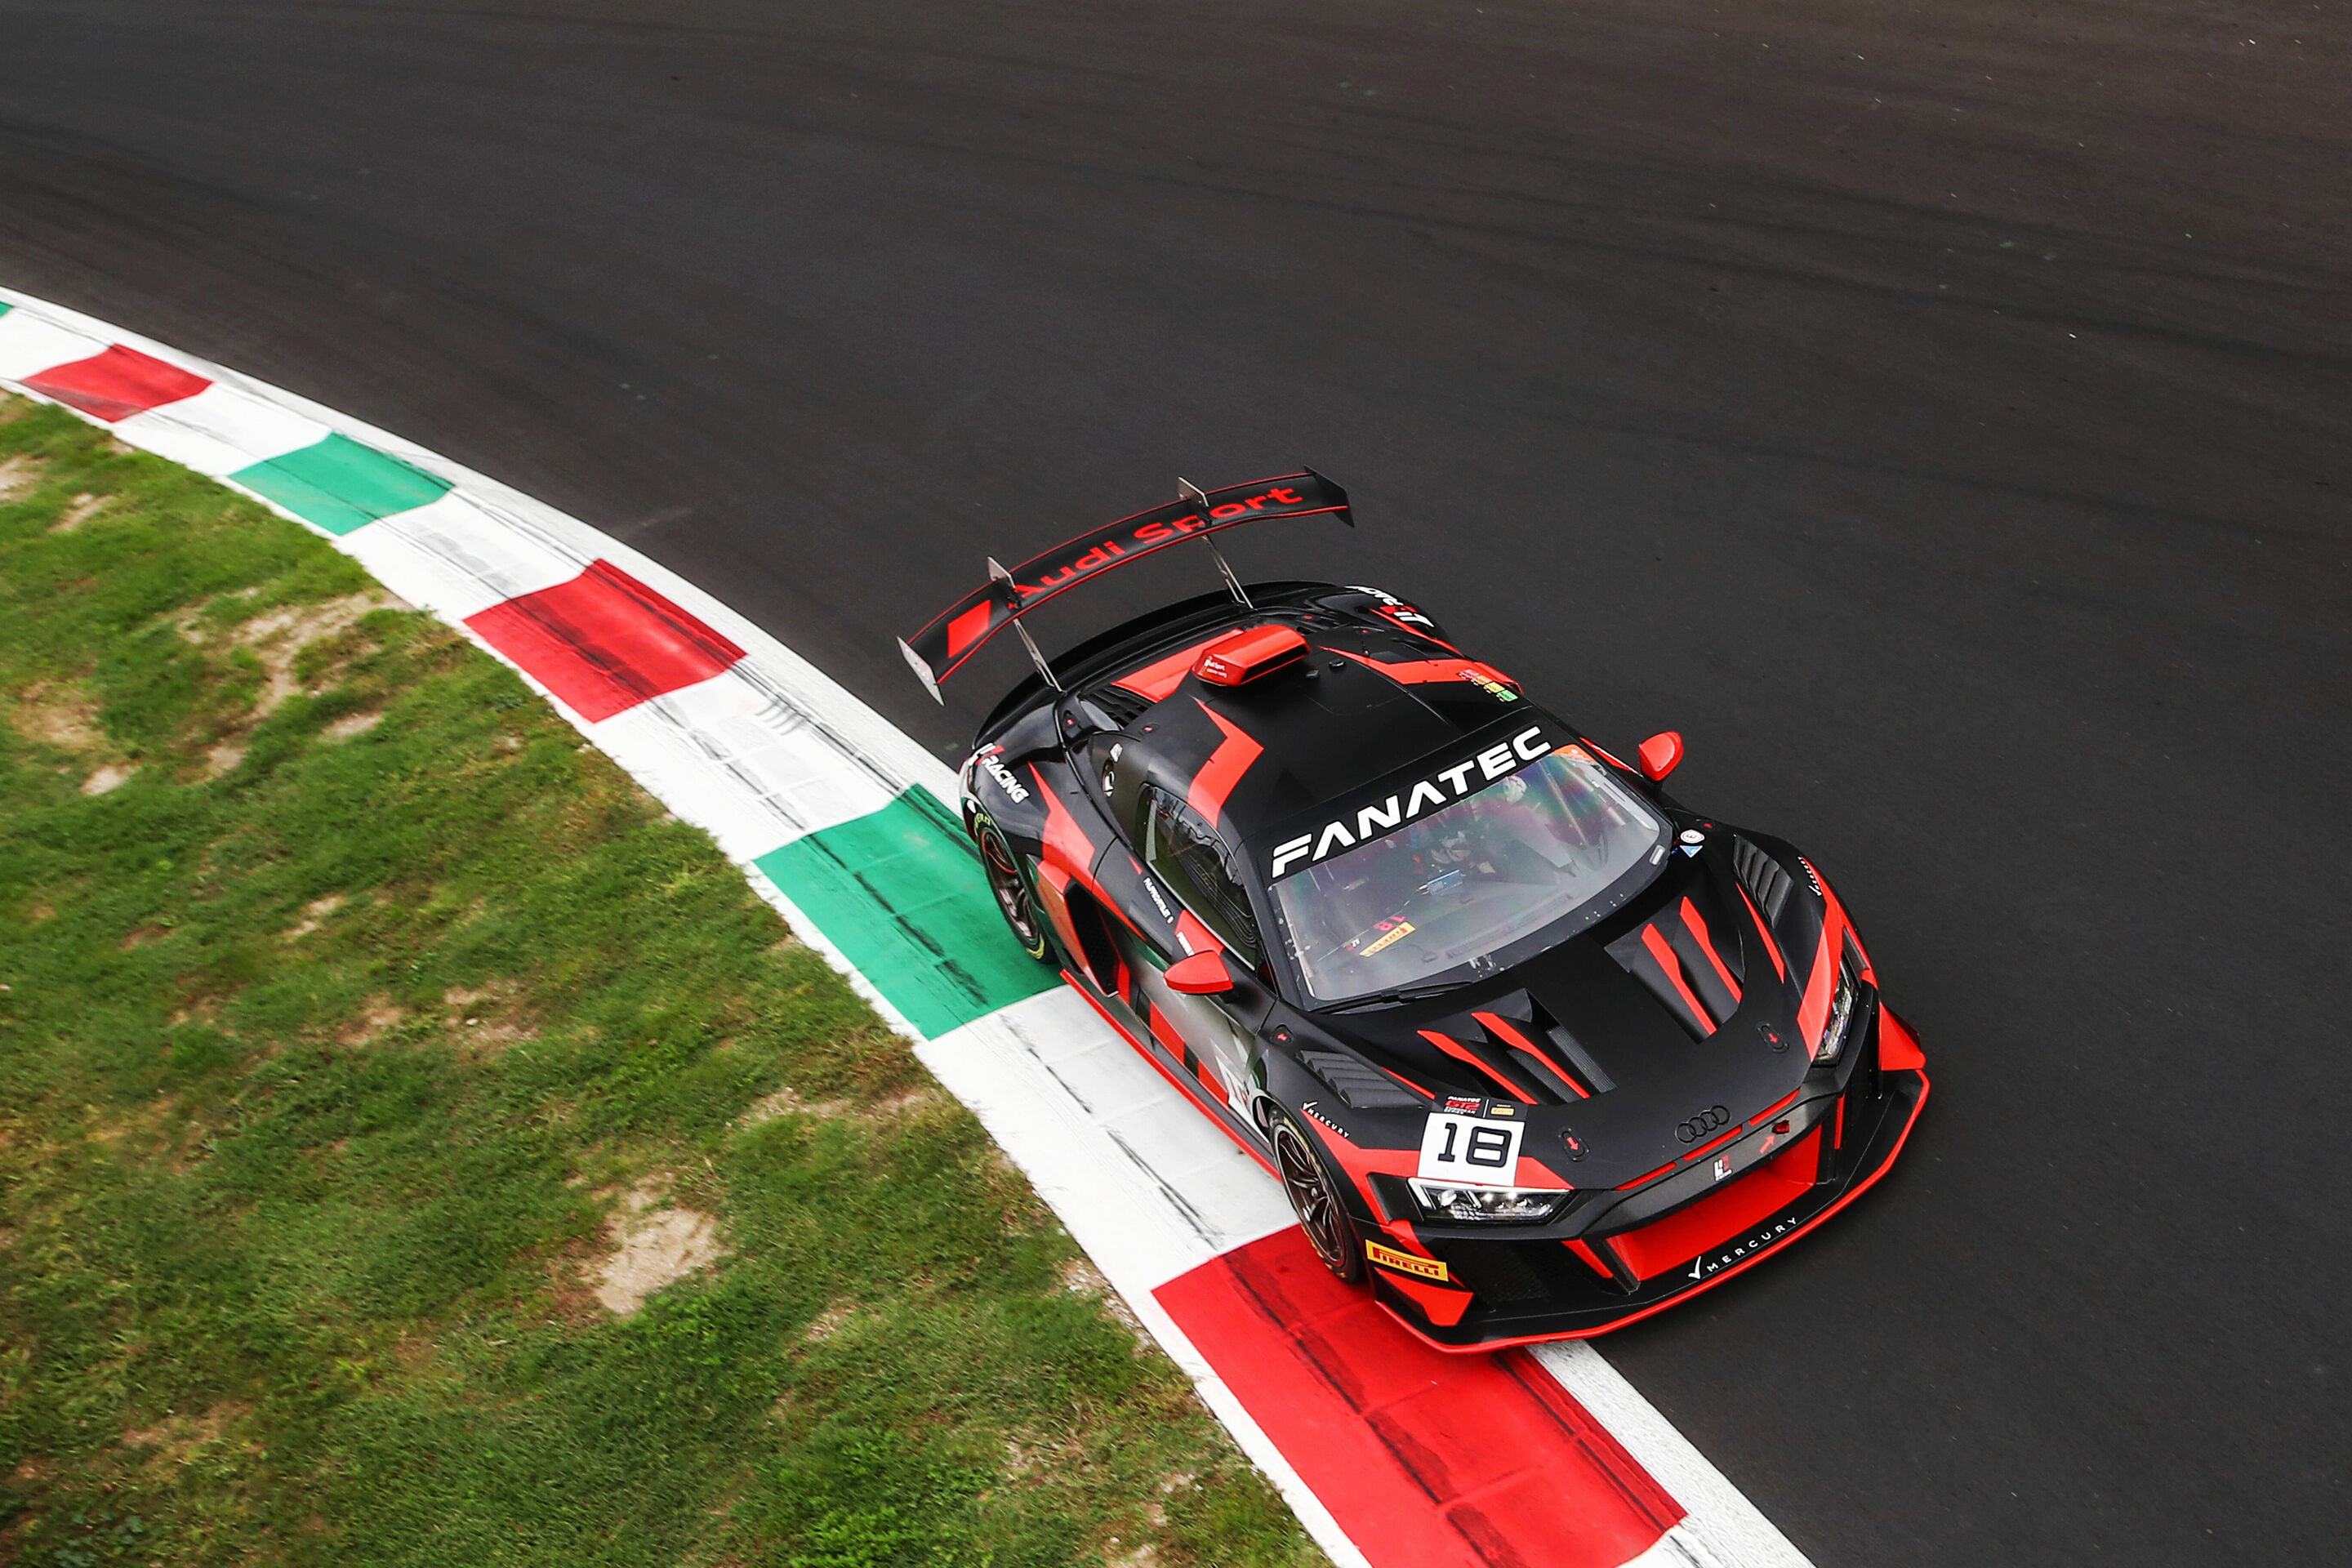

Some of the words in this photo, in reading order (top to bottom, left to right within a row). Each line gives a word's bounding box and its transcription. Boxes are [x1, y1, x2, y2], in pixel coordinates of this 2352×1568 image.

[1009, 541, 1126, 610] Audi
[1134, 488, 1303, 545] Sport
[982, 755, 1030, 804] RACING
[1272, 725, 1552, 879] FANATEC
[1307, 1108, 1350, 1138] MERCURY
[1445, 1100, 1481, 1111] GT2
[1437, 1122, 1512, 1168] 18
[1372, 1246, 1440, 1276] PIRELLI
[1706, 1217, 1797, 1272] MERCURY
